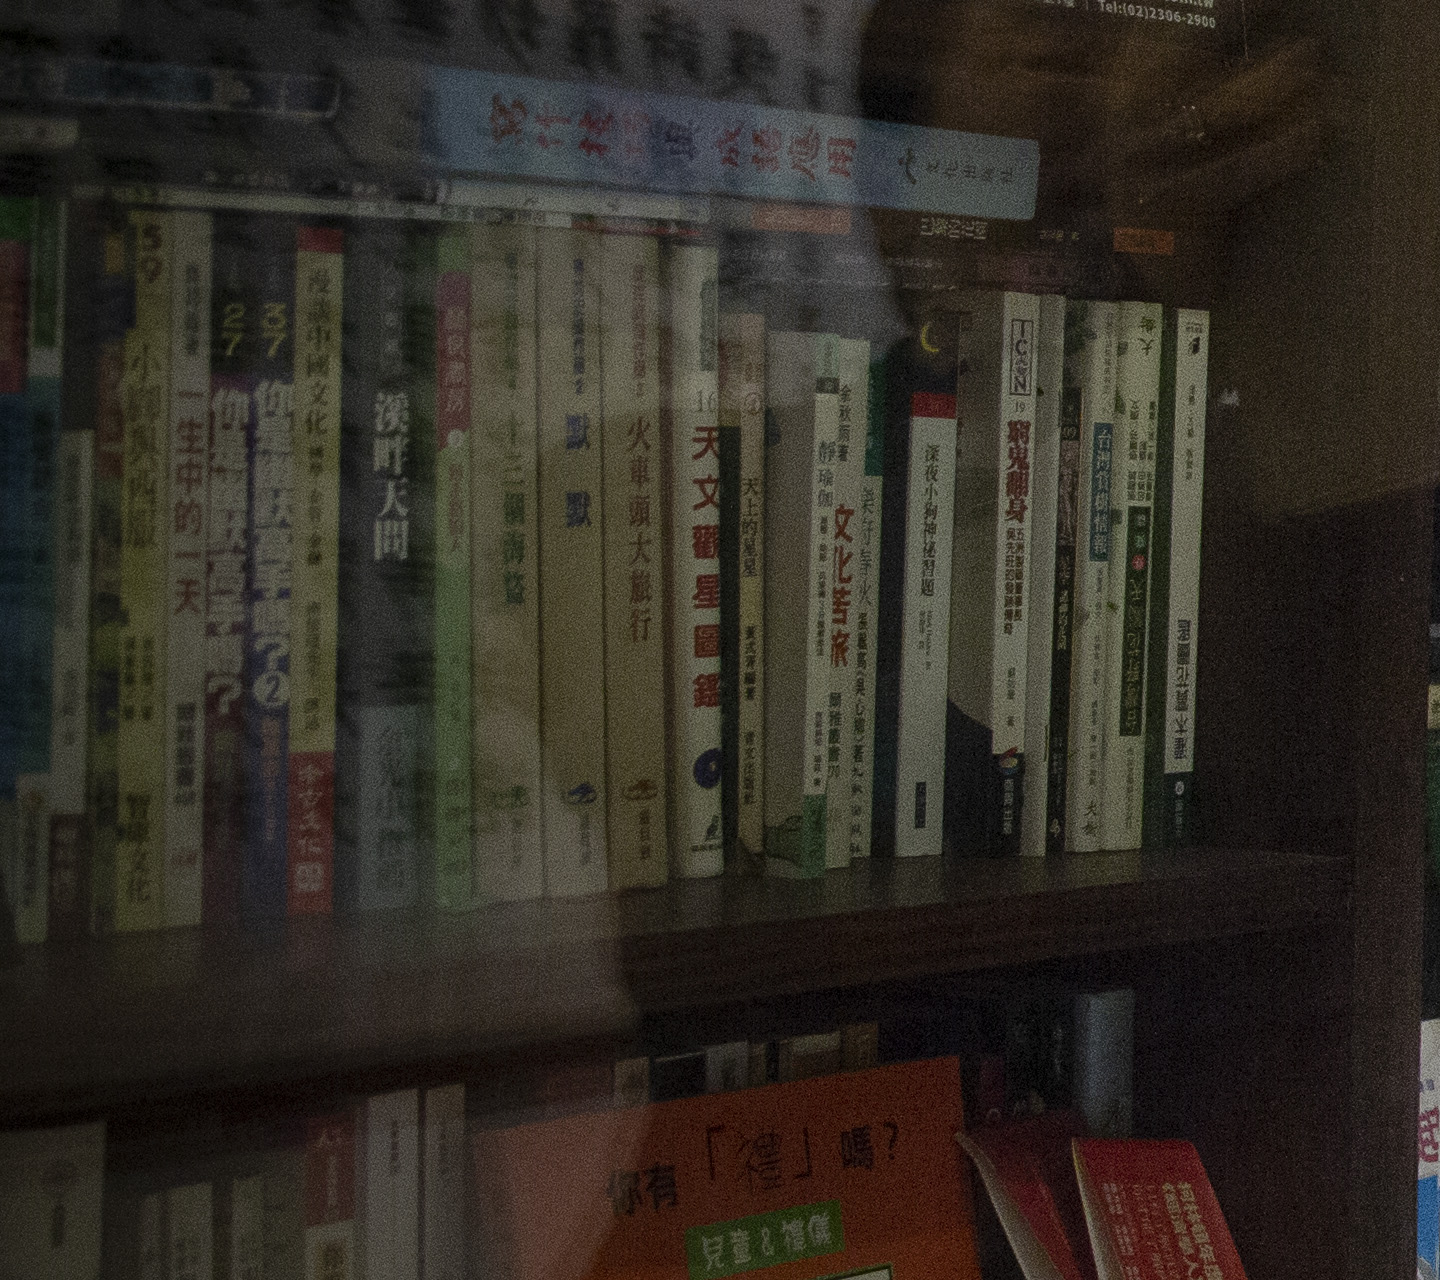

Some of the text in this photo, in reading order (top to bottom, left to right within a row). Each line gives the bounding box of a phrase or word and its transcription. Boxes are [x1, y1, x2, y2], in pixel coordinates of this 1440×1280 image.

[174, 388, 205, 616] 一生中的一天
[565, 412, 593, 529] 默默
[626, 415, 655, 644] 火車頭大旅行
[688, 424, 718, 710] 天文觀星圖鑑
[831, 503, 855, 669] 文化苦旅
